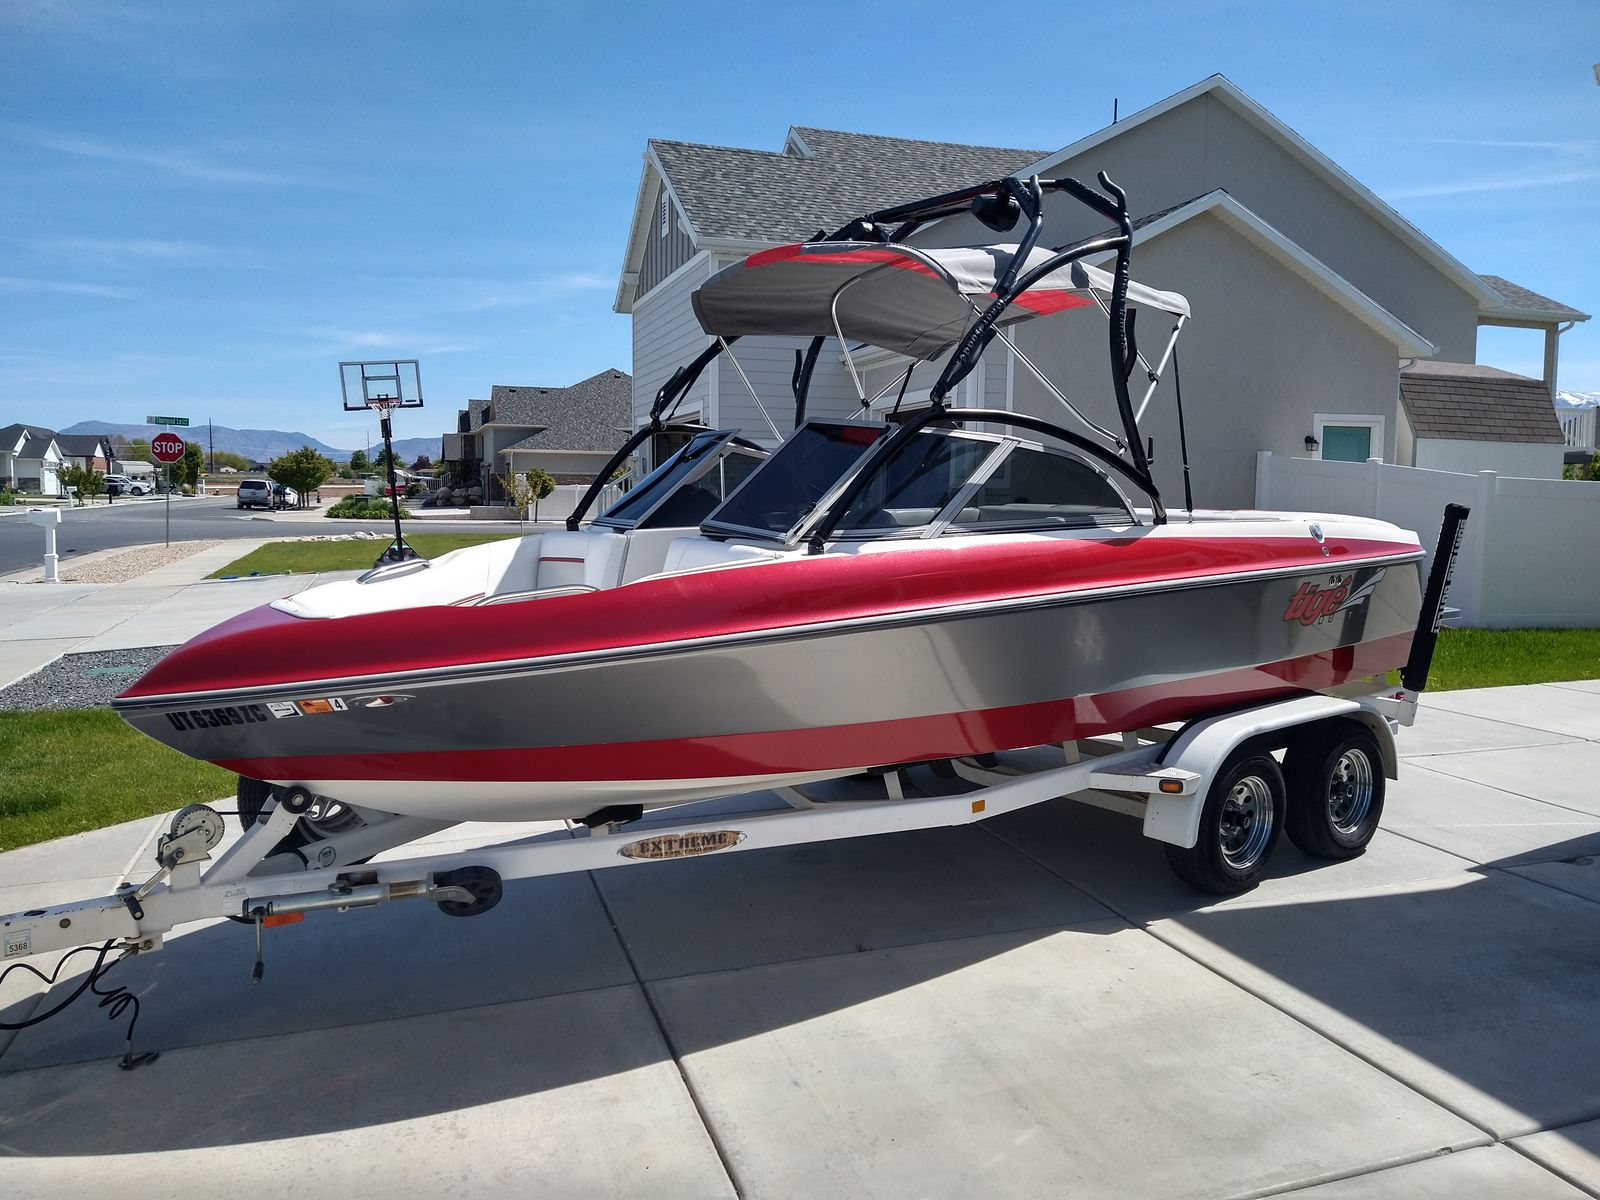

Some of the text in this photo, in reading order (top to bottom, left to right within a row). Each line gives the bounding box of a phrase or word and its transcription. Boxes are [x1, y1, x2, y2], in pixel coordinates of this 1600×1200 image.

[153, 441, 183, 454] STOP
[334, 699, 343, 710] 4
[9, 942, 28, 953] 5368
